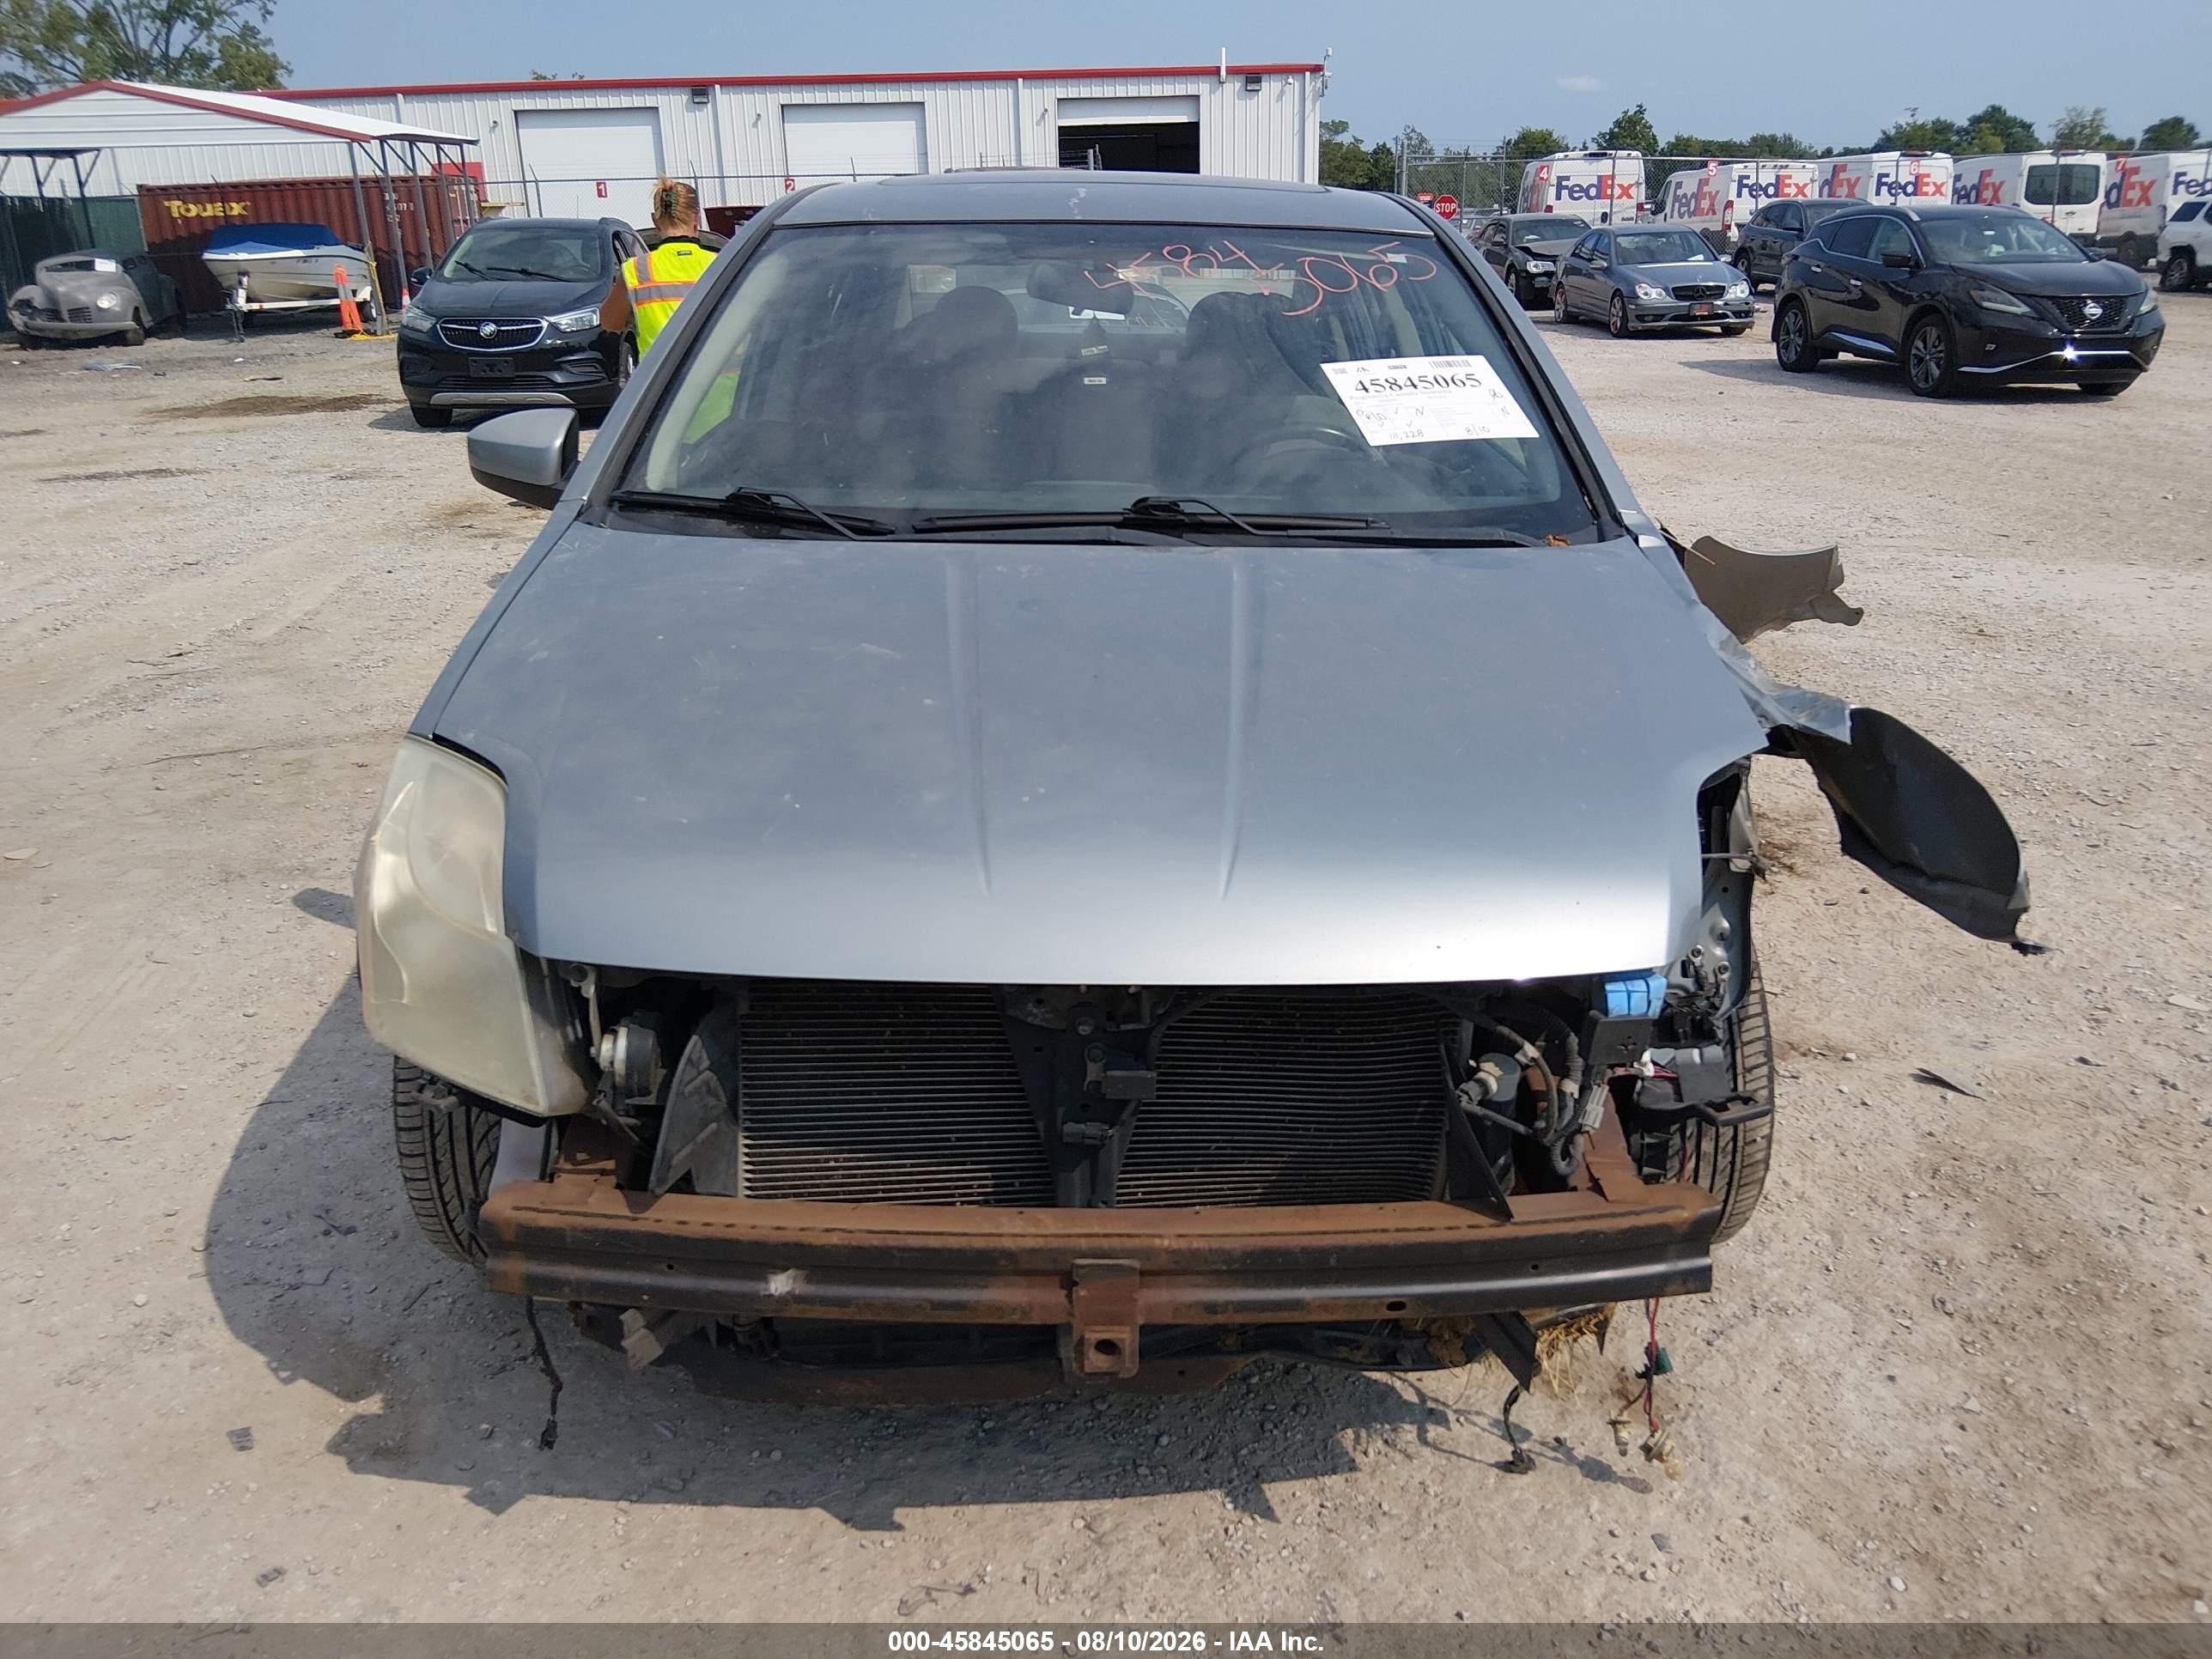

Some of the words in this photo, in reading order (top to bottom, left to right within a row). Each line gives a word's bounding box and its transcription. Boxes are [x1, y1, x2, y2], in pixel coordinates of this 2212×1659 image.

[1555, 174, 1635, 201] FedEx
[1735, 173, 1810, 199] FedEx
[1875, 173, 1946, 197] FedEx
[1435, 202, 1456, 213] STOP
[1669, 177, 1720, 220] FedEx
[1354, 373, 1482, 394] 45845065
